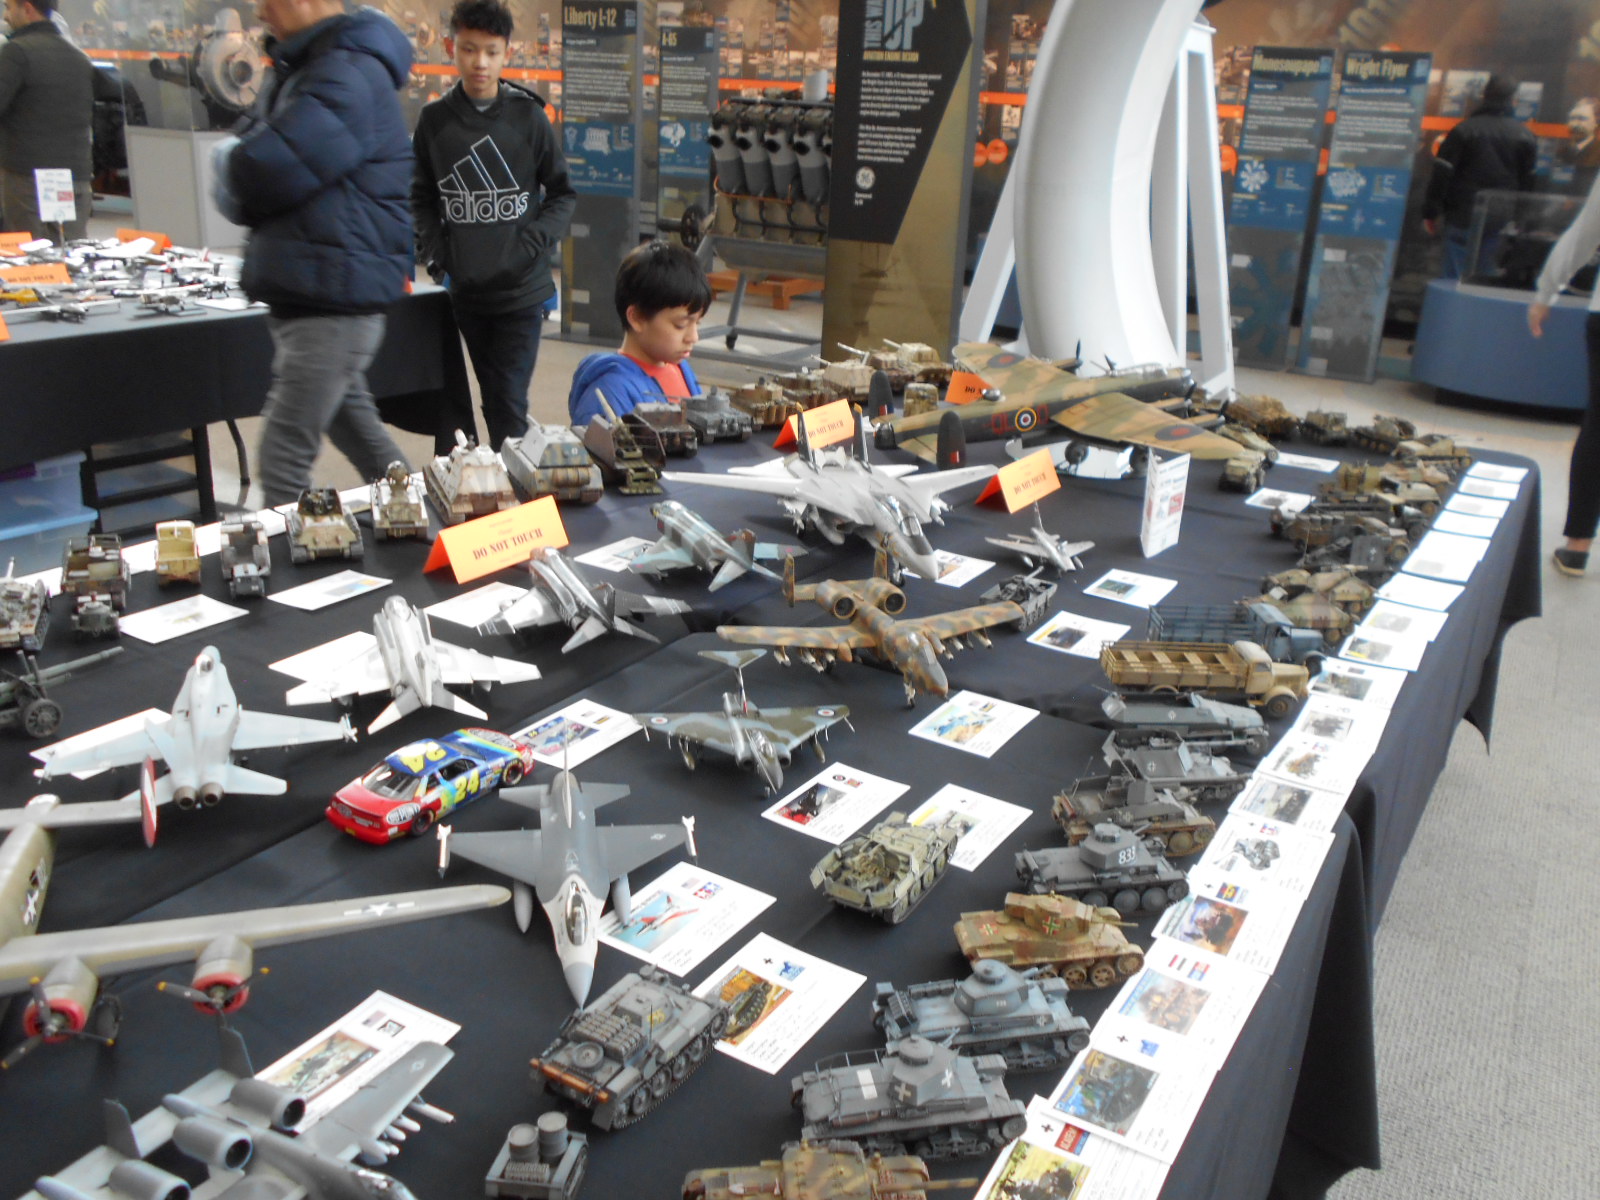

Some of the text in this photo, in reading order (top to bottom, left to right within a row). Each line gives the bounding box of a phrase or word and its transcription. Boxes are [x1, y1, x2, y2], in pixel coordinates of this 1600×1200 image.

[564, 6, 617, 31] Liberty L-12
[1347, 58, 1410, 81] Wright Flyer
[472, 547, 488, 560] DO
[489, 540, 509, 553] NOT
[511, 528, 543, 547] TOUCH
[454, 769, 480, 804] 24
